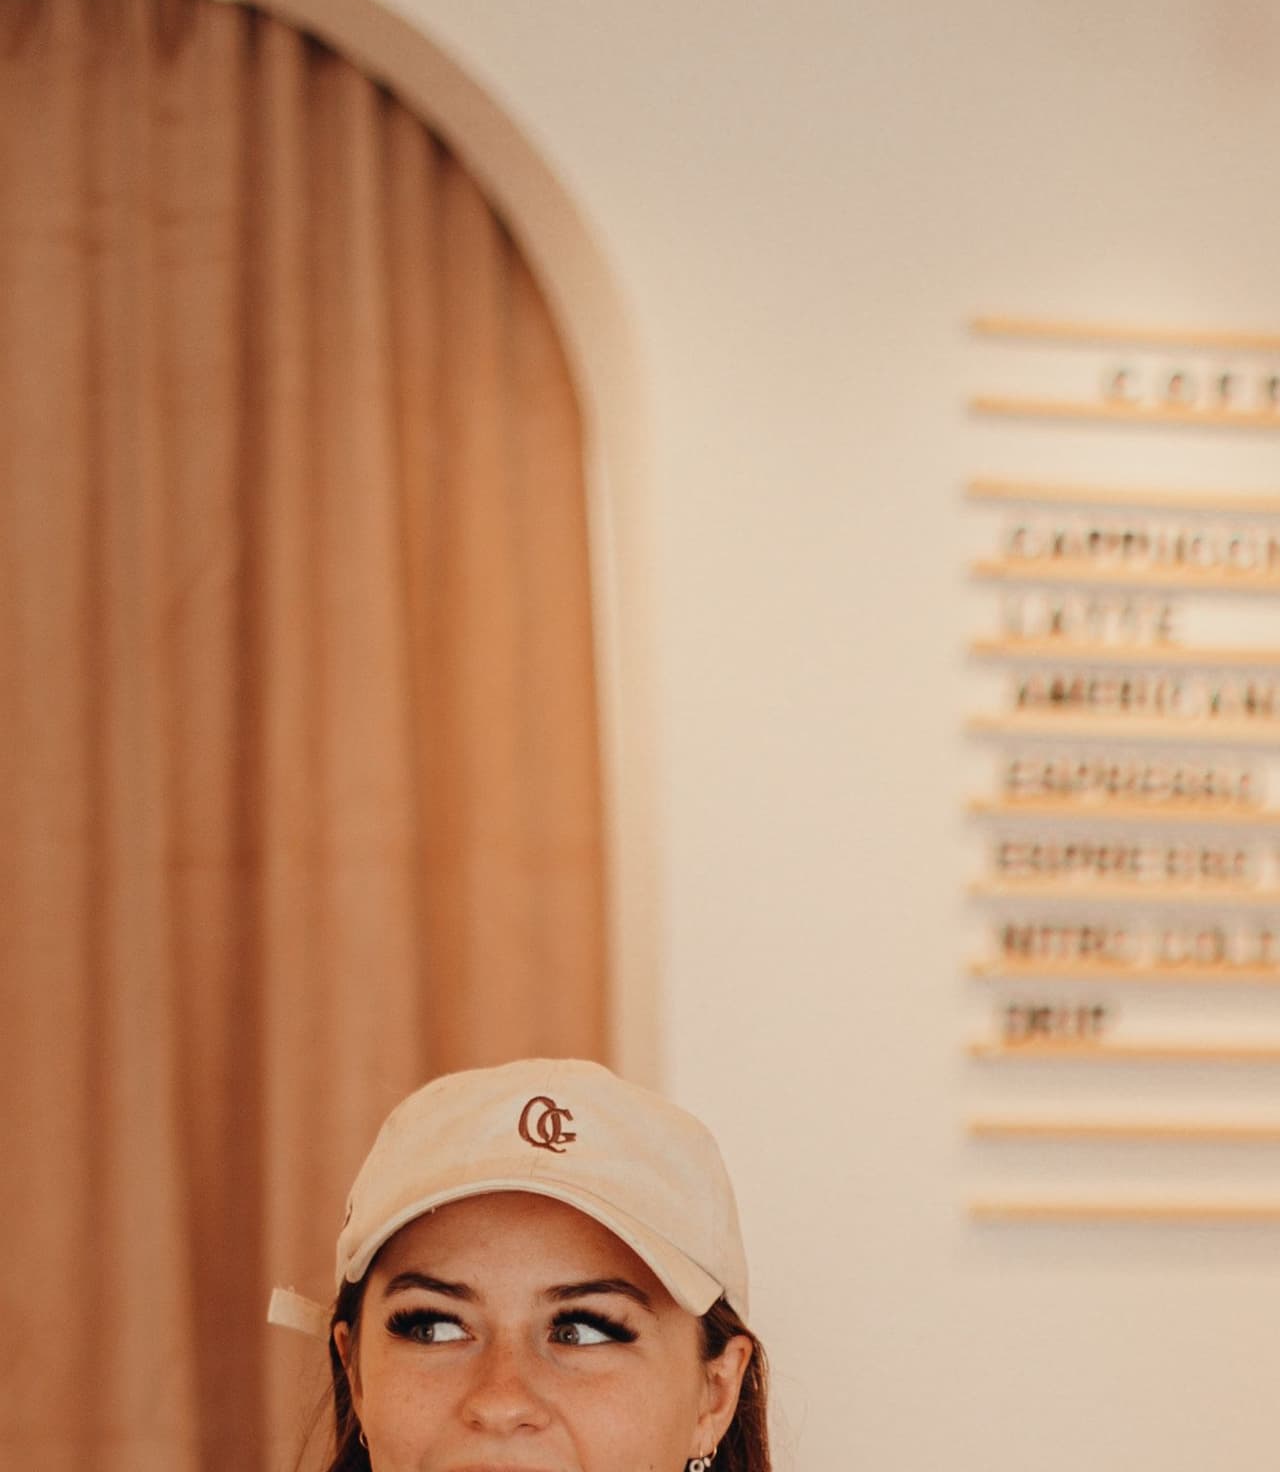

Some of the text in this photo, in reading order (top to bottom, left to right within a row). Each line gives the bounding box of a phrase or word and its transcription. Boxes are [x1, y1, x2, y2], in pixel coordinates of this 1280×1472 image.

[1007, 594, 1178, 642] LATTE
[1003, 756, 1260, 806] ESPRESSO
[995, 838, 1253, 886] ESPRESSO
[999, 922, 1130, 968] NITRO
[1001, 998, 1112, 1044] DRIP
